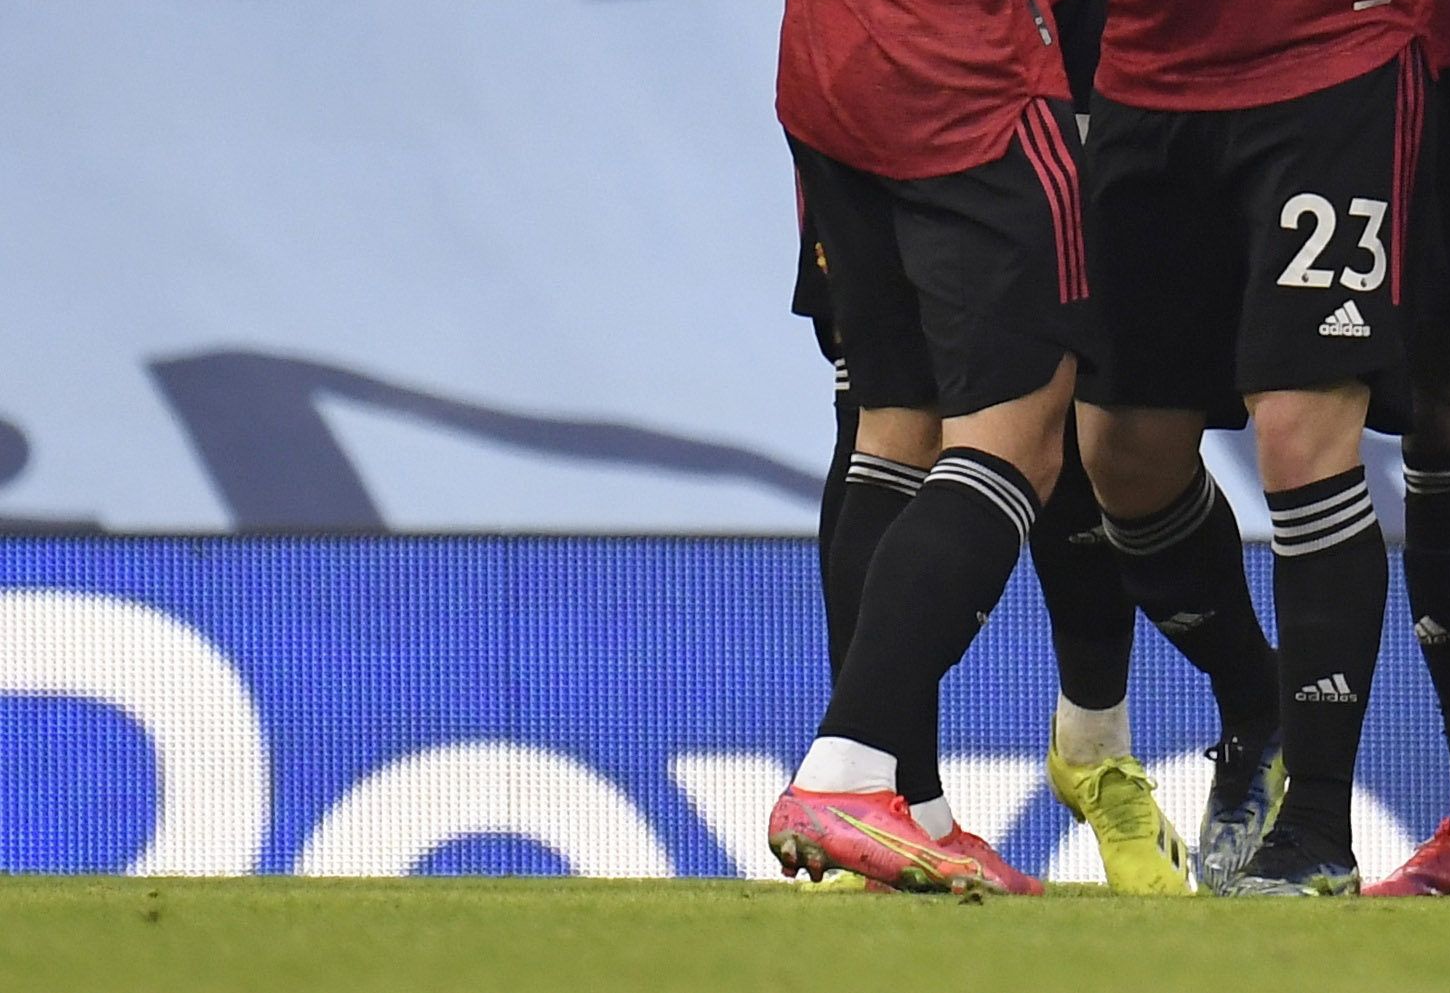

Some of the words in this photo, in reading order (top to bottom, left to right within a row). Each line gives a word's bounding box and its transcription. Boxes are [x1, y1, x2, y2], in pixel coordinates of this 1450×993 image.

[1276, 192, 1388, 292] 23
[1318, 323, 1371, 337] adidas
[1295, 691, 1358, 703] adidas
